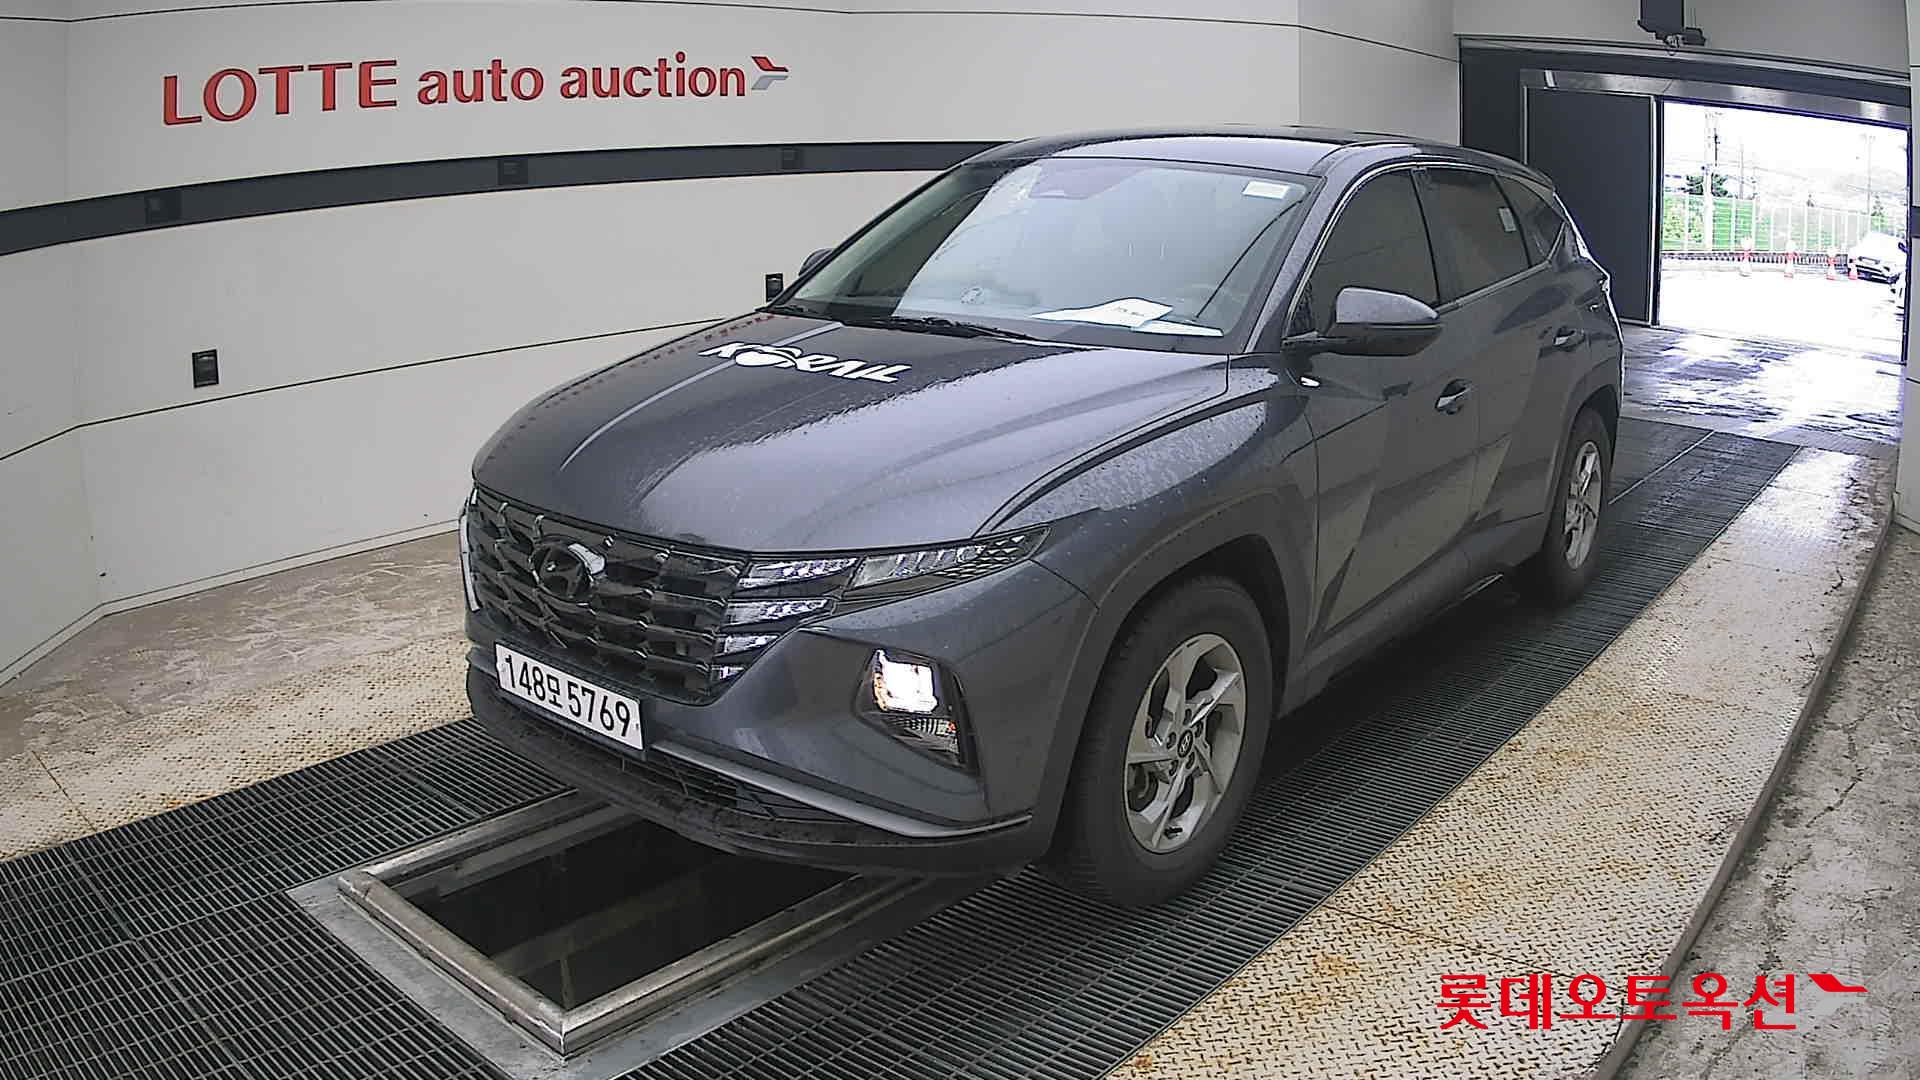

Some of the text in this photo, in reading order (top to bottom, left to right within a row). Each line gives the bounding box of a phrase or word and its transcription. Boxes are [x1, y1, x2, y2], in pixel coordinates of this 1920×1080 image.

[163, 51, 747, 126] LOTTE auto auction
[567, 681, 631, 737] 5769
